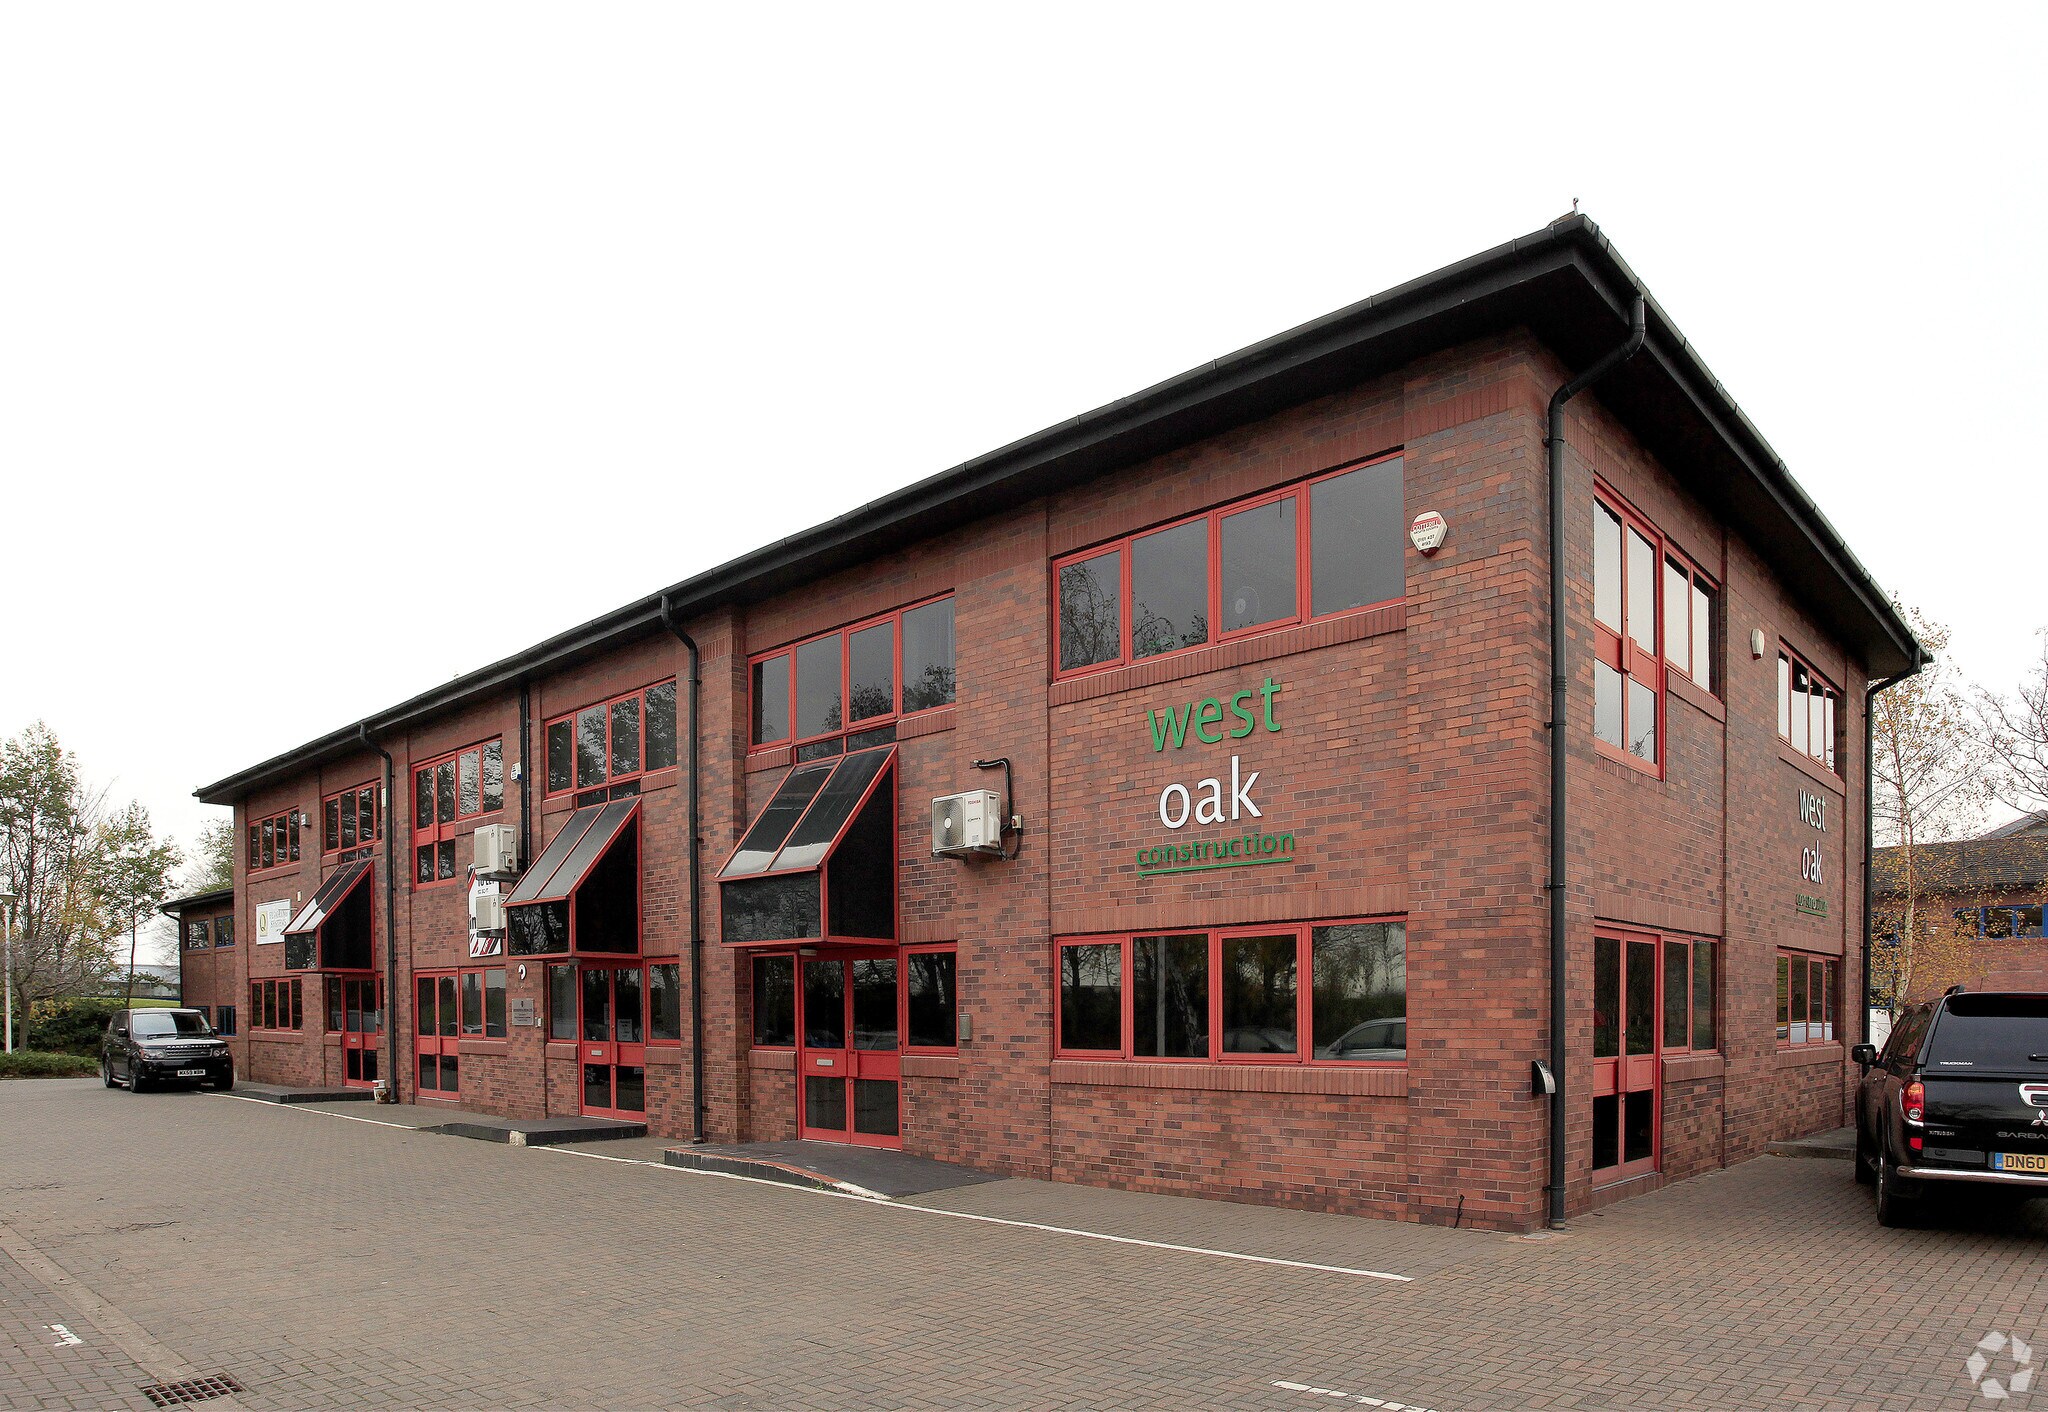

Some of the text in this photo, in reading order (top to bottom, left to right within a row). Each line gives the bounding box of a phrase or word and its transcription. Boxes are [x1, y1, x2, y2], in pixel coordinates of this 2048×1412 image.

[1147, 677, 1281, 752] west
[1159, 755, 1263, 829] oak
[1799, 787, 1827, 833] west
[1136, 832, 1294, 866] construction
[1802, 839, 1823, 885] oak
[1996, 1131, 2048, 1140] BARBA
[2005, 1155, 2046, 1170] DN60
